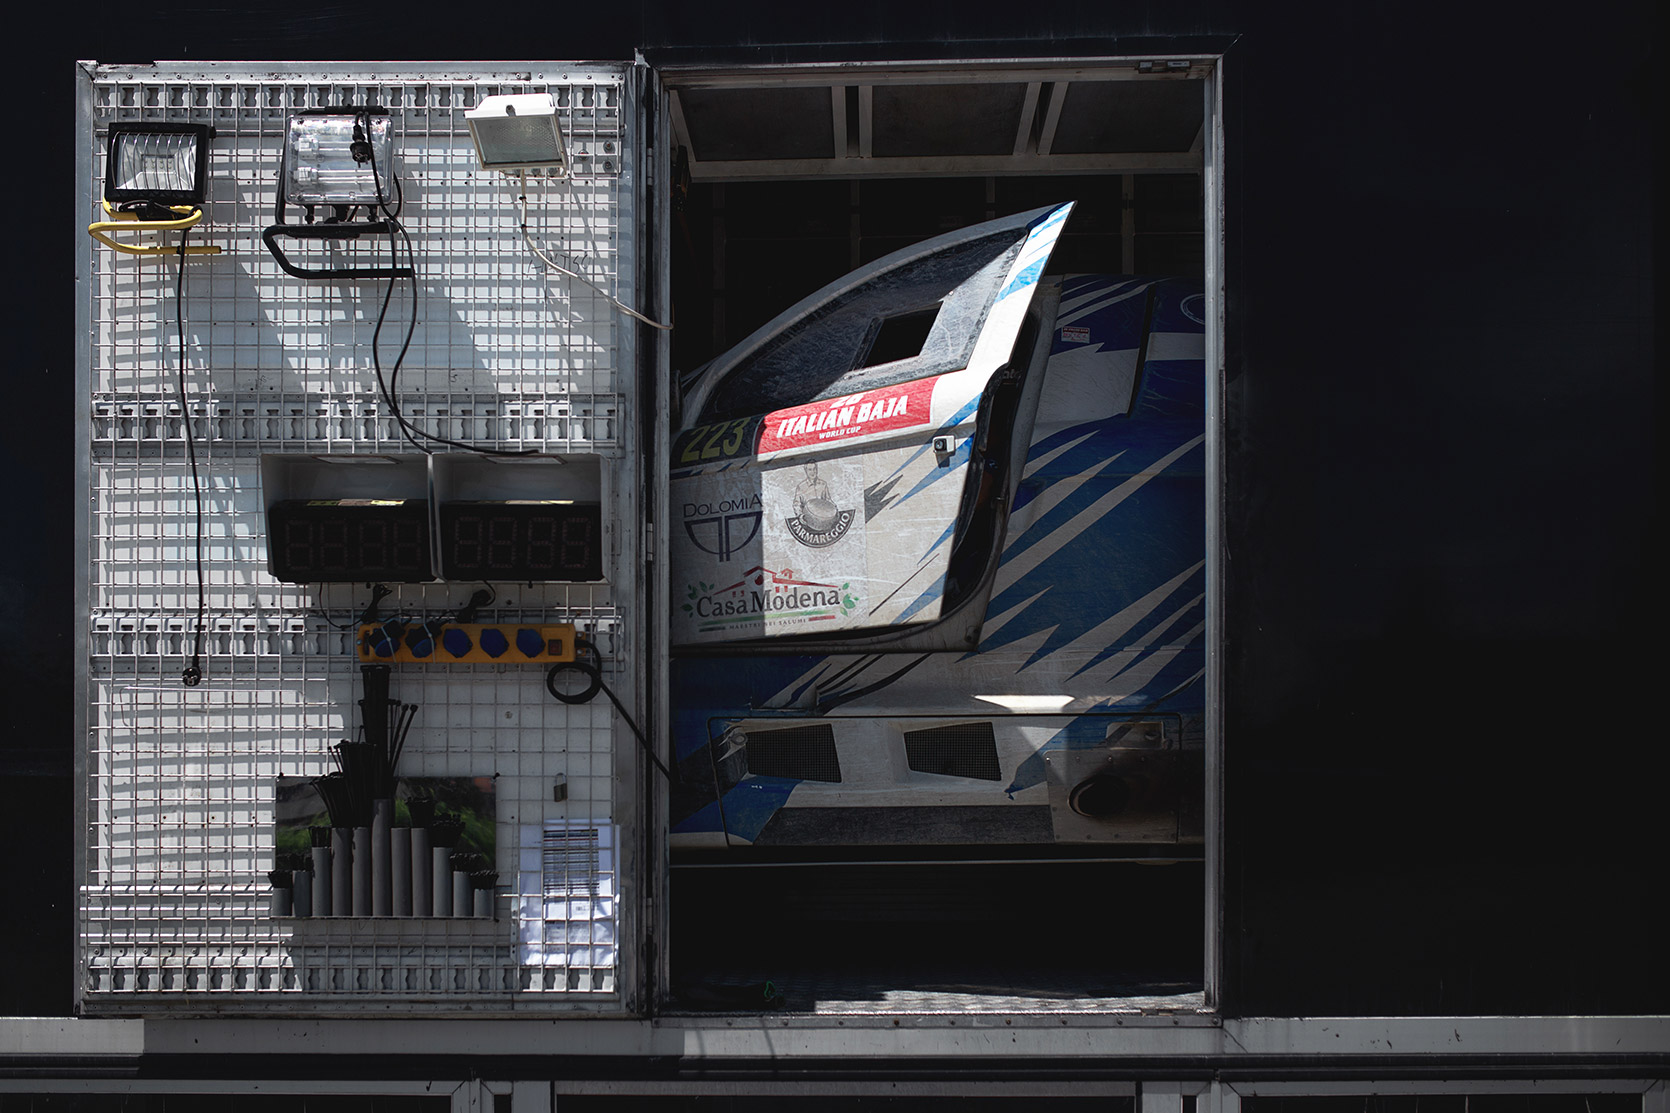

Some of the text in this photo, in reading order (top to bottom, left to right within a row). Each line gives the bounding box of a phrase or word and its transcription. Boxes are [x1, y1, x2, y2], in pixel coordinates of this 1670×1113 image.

[776, 395, 909, 438] ITALIAN BAJA
[680, 417, 752, 463] 223
[818, 426, 862, 439] WORLD CUP
[683, 493, 763, 518] DOLOMIA
[791, 512, 850, 544] PARMAREGGIO
[697, 587, 841, 618] Casa Modena
